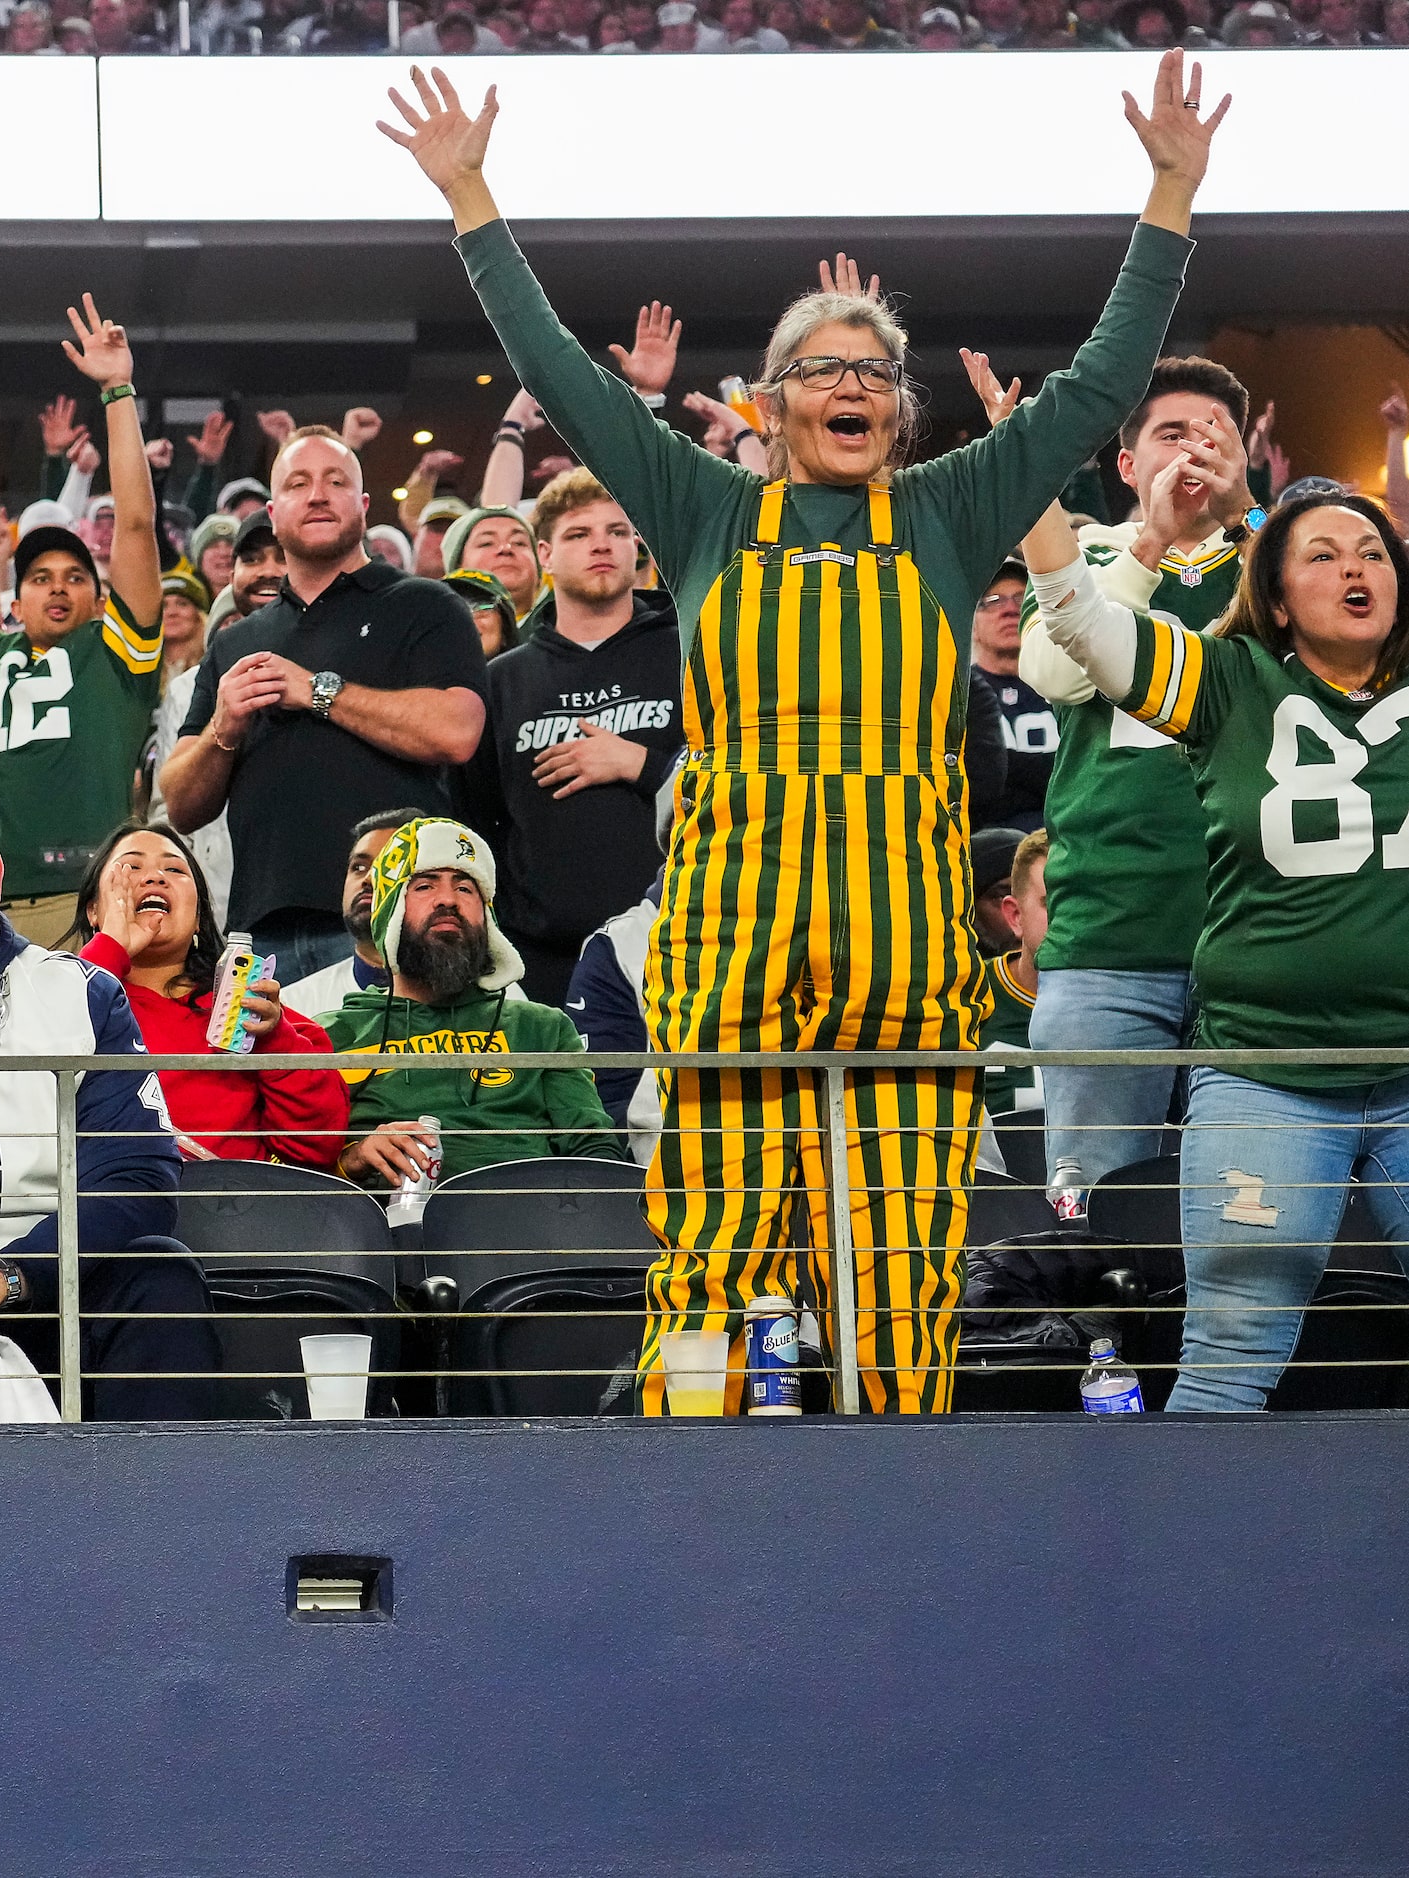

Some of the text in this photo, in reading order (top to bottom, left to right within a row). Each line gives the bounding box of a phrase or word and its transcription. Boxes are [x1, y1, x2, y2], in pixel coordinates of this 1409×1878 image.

[793, 553, 853, 563] GAME BIBS
[1184, 574, 1199, 583] NFL
[559, 684, 622, 707] TEXAS
[764, 1334, 791, 1351] BLUE
